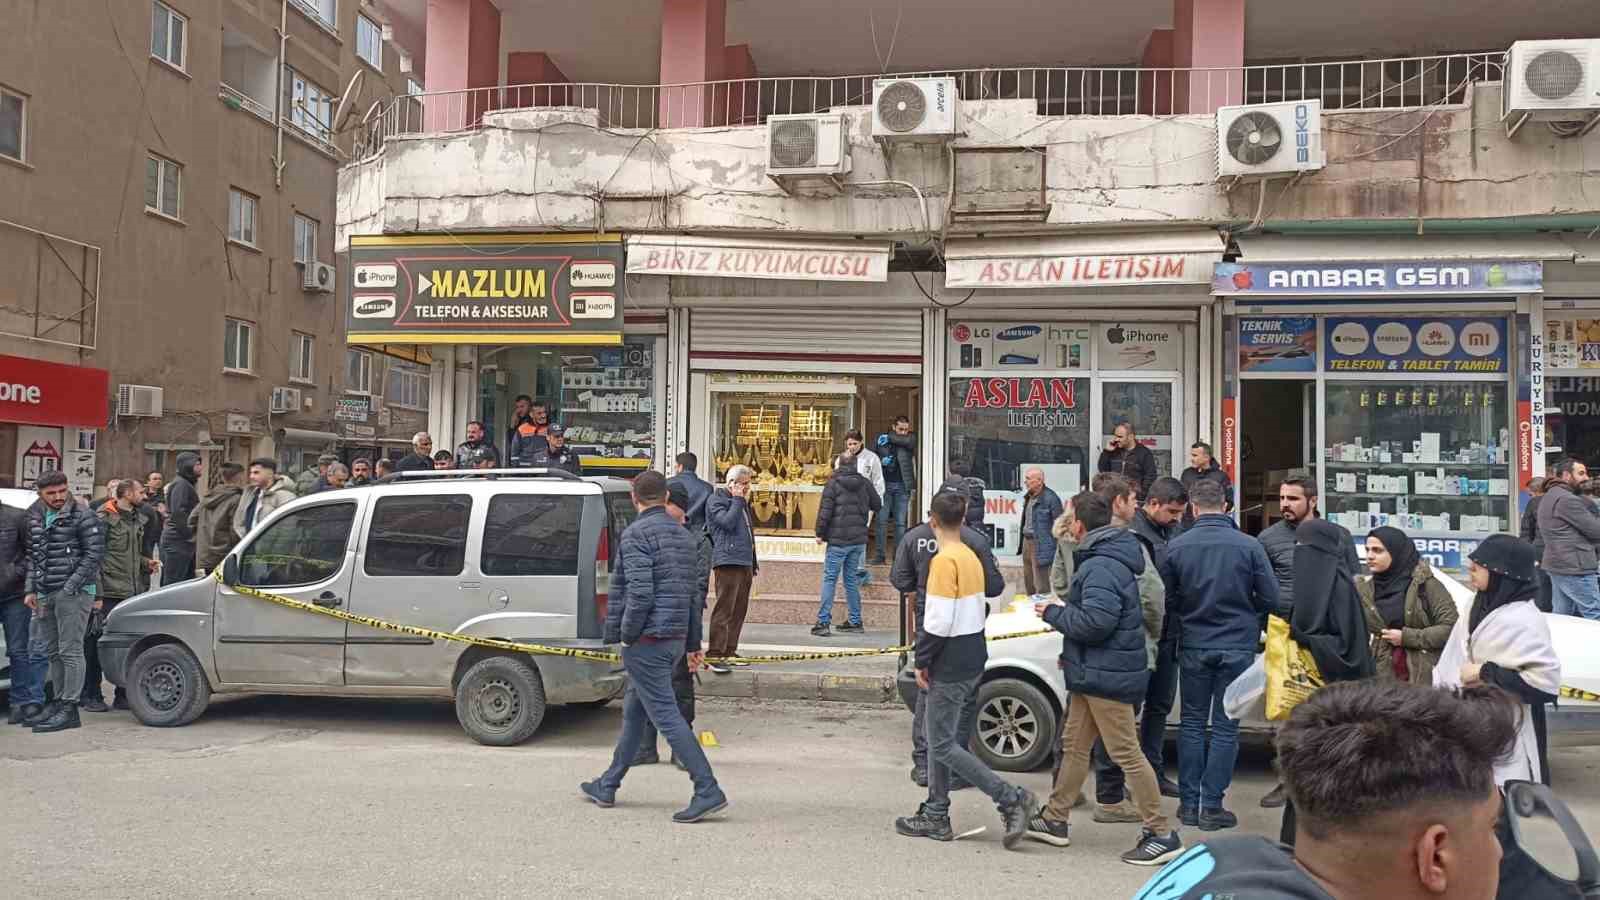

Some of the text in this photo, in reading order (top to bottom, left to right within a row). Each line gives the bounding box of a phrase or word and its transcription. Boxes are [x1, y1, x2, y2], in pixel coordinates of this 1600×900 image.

[1295, 105, 1309, 163] BEKO
[646, 249, 871, 277] BİRİZ KUYUMCUSU
[977, 255, 1185, 282] ASLAN İLETİŞİM
[368, 271, 396, 282] iPhone
[431, 269, 546, 298] MAZLUM
[584, 271, 614, 280] HUAWEI
[1268, 268, 1386, 288] AMBAR
[414, 305, 548, 319] TELEFON & AKSESUAR
[973, 328, 990, 339] LG
[1001, 329, 1038, 338] SAMSUNG
[1048, 326, 1089, 340] htc
[1126, 329, 1169, 343] iPhone
[1241, 320, 1295, 345] TEKNİK SERVİS
[1329, 358, 1501, 371] TELEFON & TABLET TAMİRİ
[0, 382, 41, 404] one
[964, 378, 1076, 409] ASLAN
[1007, 409, 1076, 431] İLETİŞİM
[1520, 431, 1531, 472] vodafone
[985, 496, 1018, 515] NİK
[917, 538, 938, 553] PO
[1415, 539, 1460, 552] BAR
